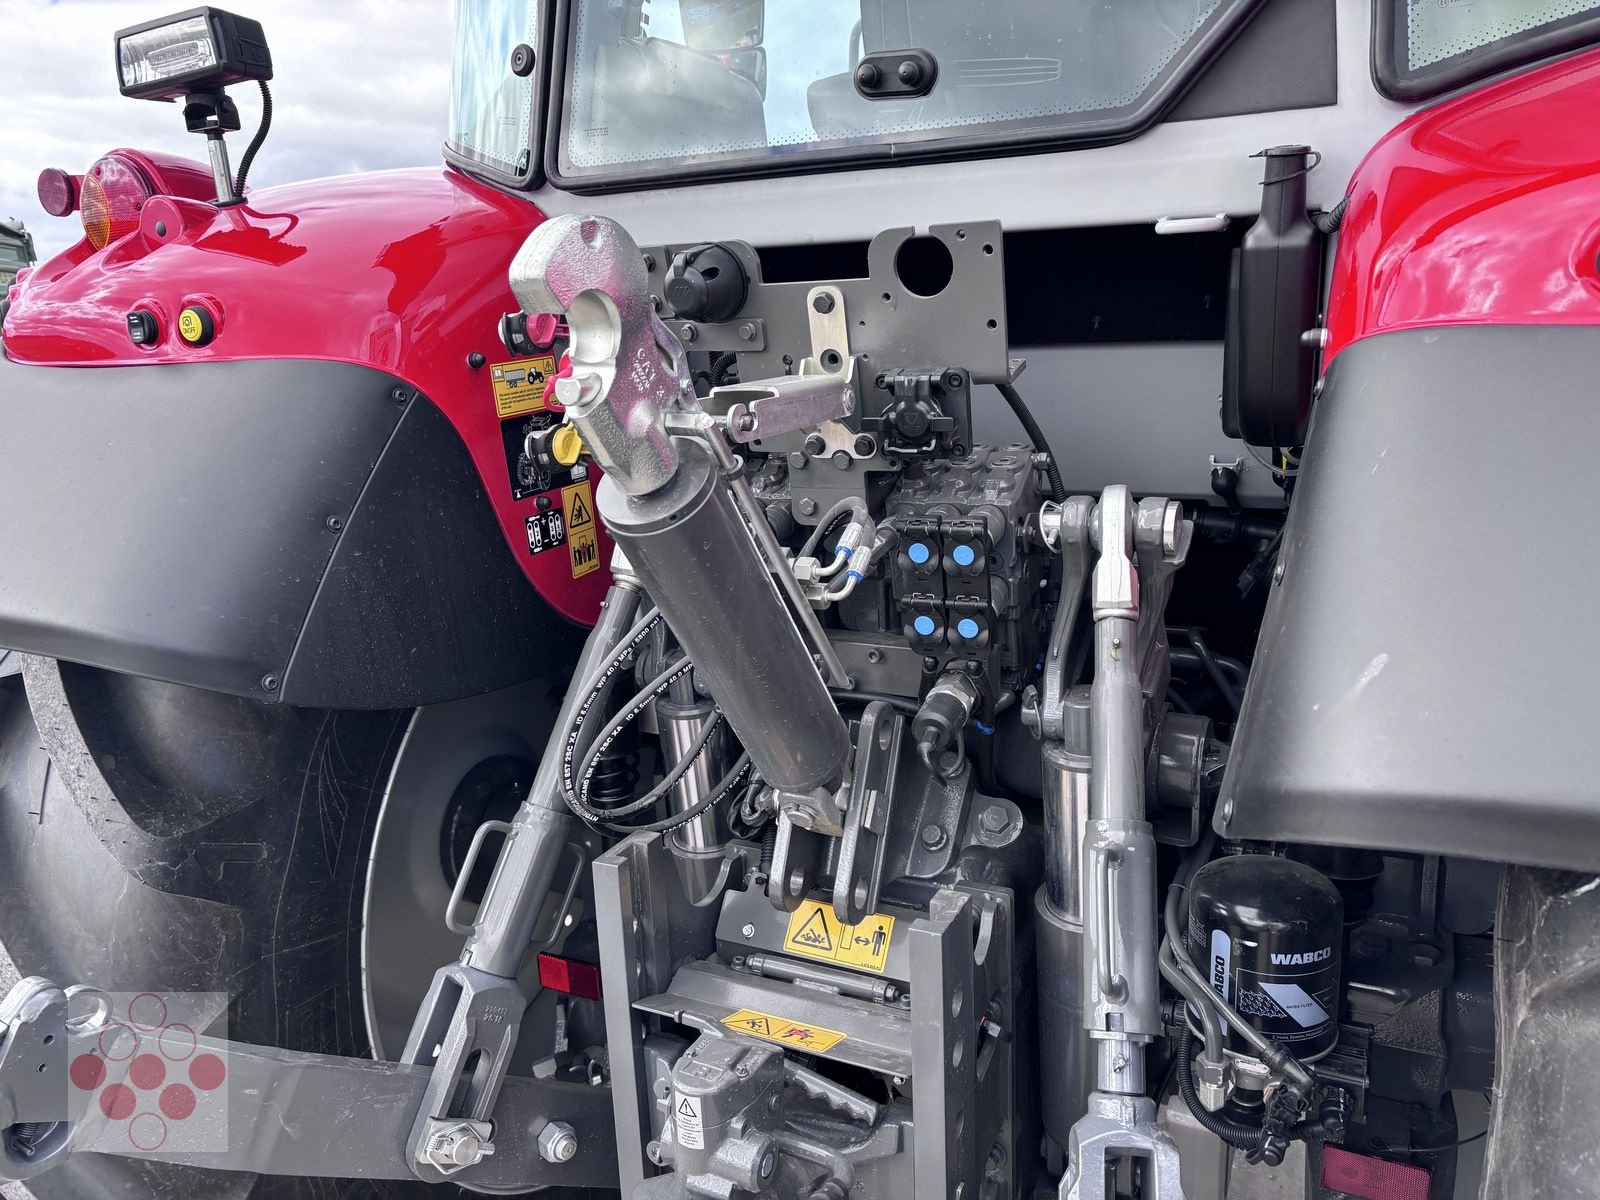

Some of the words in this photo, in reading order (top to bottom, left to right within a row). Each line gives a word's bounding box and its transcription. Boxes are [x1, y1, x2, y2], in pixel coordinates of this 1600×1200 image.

[650, 616, 660, 630] psi
[634, 627, 650, 644] 5800
[618, 648, 632, 662] MPa
[606, 662, 620, 676] 40.0
[596, 676, 608, 689] WP
[580, 692, 598, 714] 6.5mm
[612, 726, 624, 736] XA
[656, 682, 668, 693] WP
[669, 672, 682, 684] 40.0
[682, 664, 693, 672] MP
[576, 716, 584, 724] ID
[568, 732, 578, 744] XA
[565, 746, 573, 762] 2SC
[564, 778, 572, 790] EN
[1270, 947, 1332, 966] WABCO
